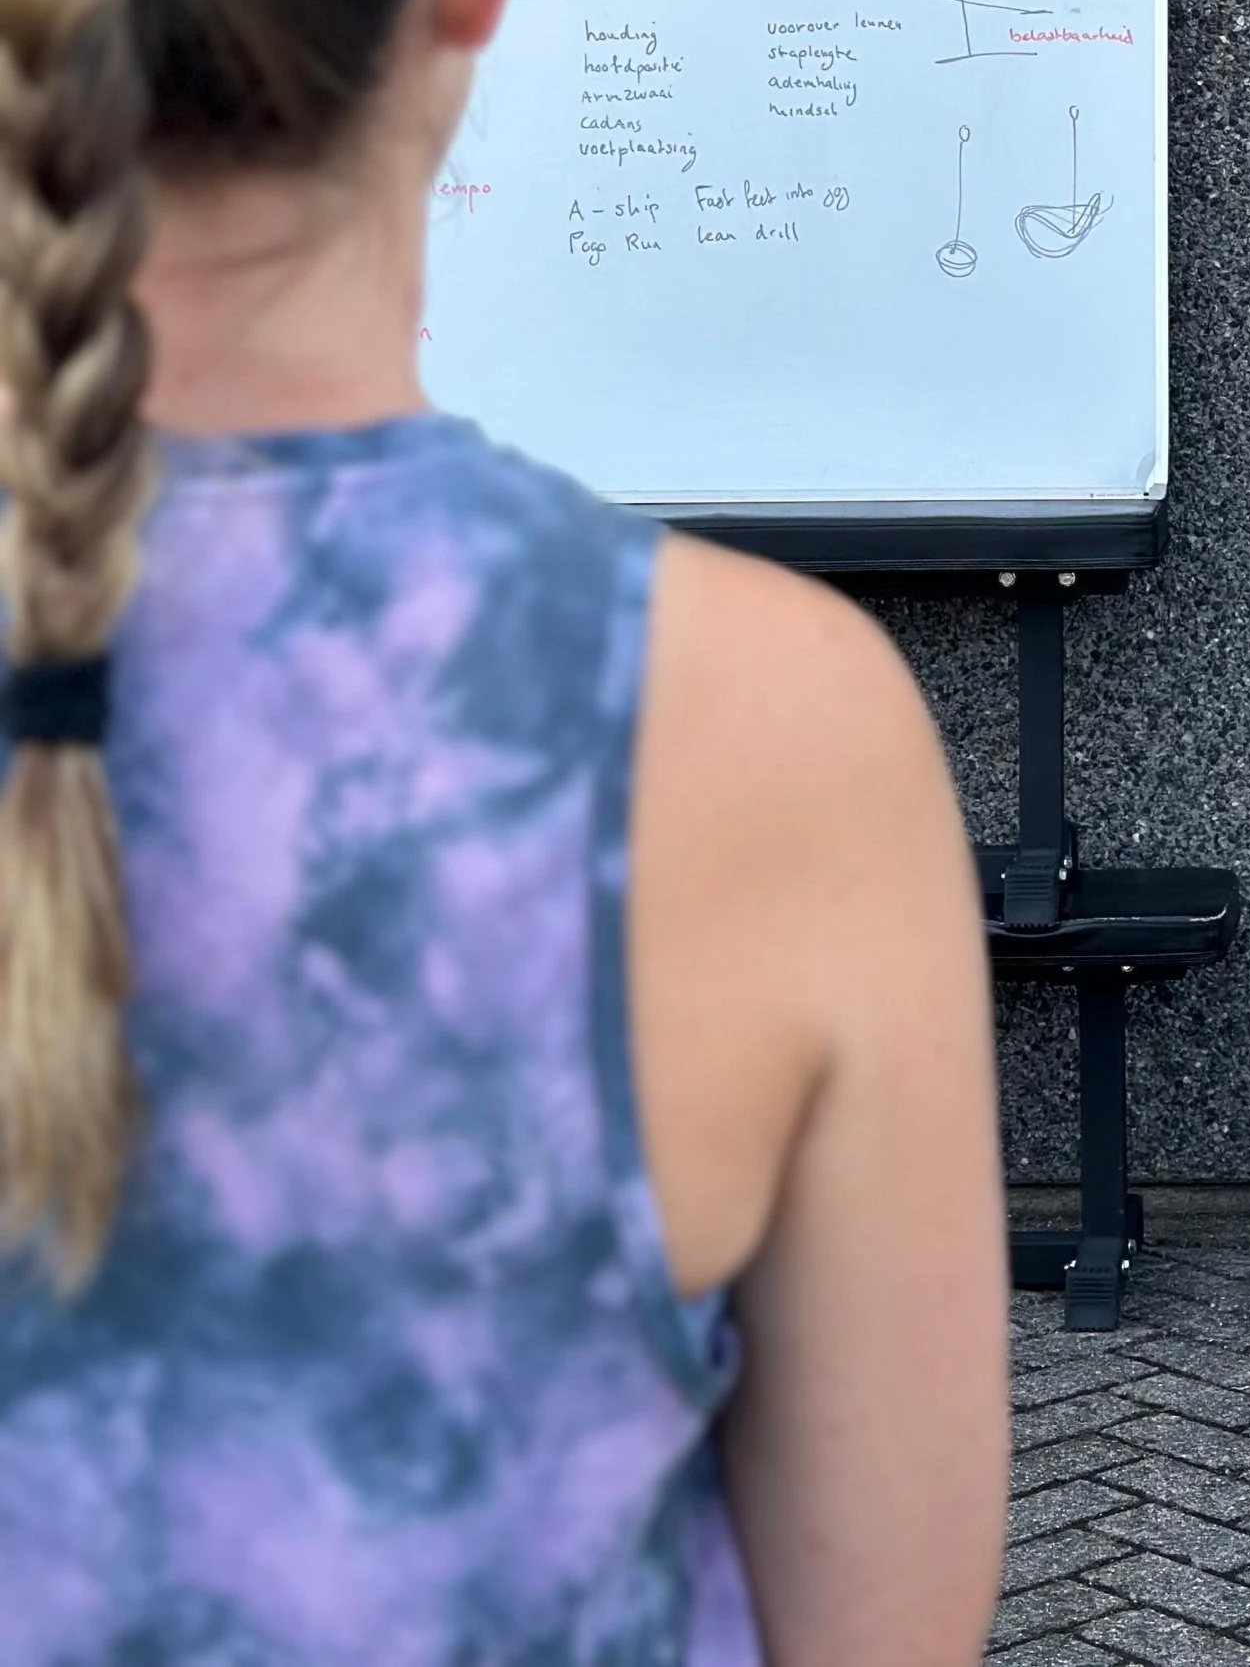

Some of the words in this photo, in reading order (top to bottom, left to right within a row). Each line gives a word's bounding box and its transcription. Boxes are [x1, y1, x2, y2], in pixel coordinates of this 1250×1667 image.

[584, 19, 658, 59] houding
[767, 21, 840, 35] voorover
[584, 50, 684, 87] hoofdpositie
[767, 44, 858, 72] staplengte
[768, 101, 838, 118] mindset
[579, 128, 697, 174] voetplaatsing
[694, 184, 735, 212] Fast
[785, 182, 814, 201] into
[755, 221, 799, 242] drill
[569, 230, 607, 267] Pogo
[625, 232, 662, 252] Run
